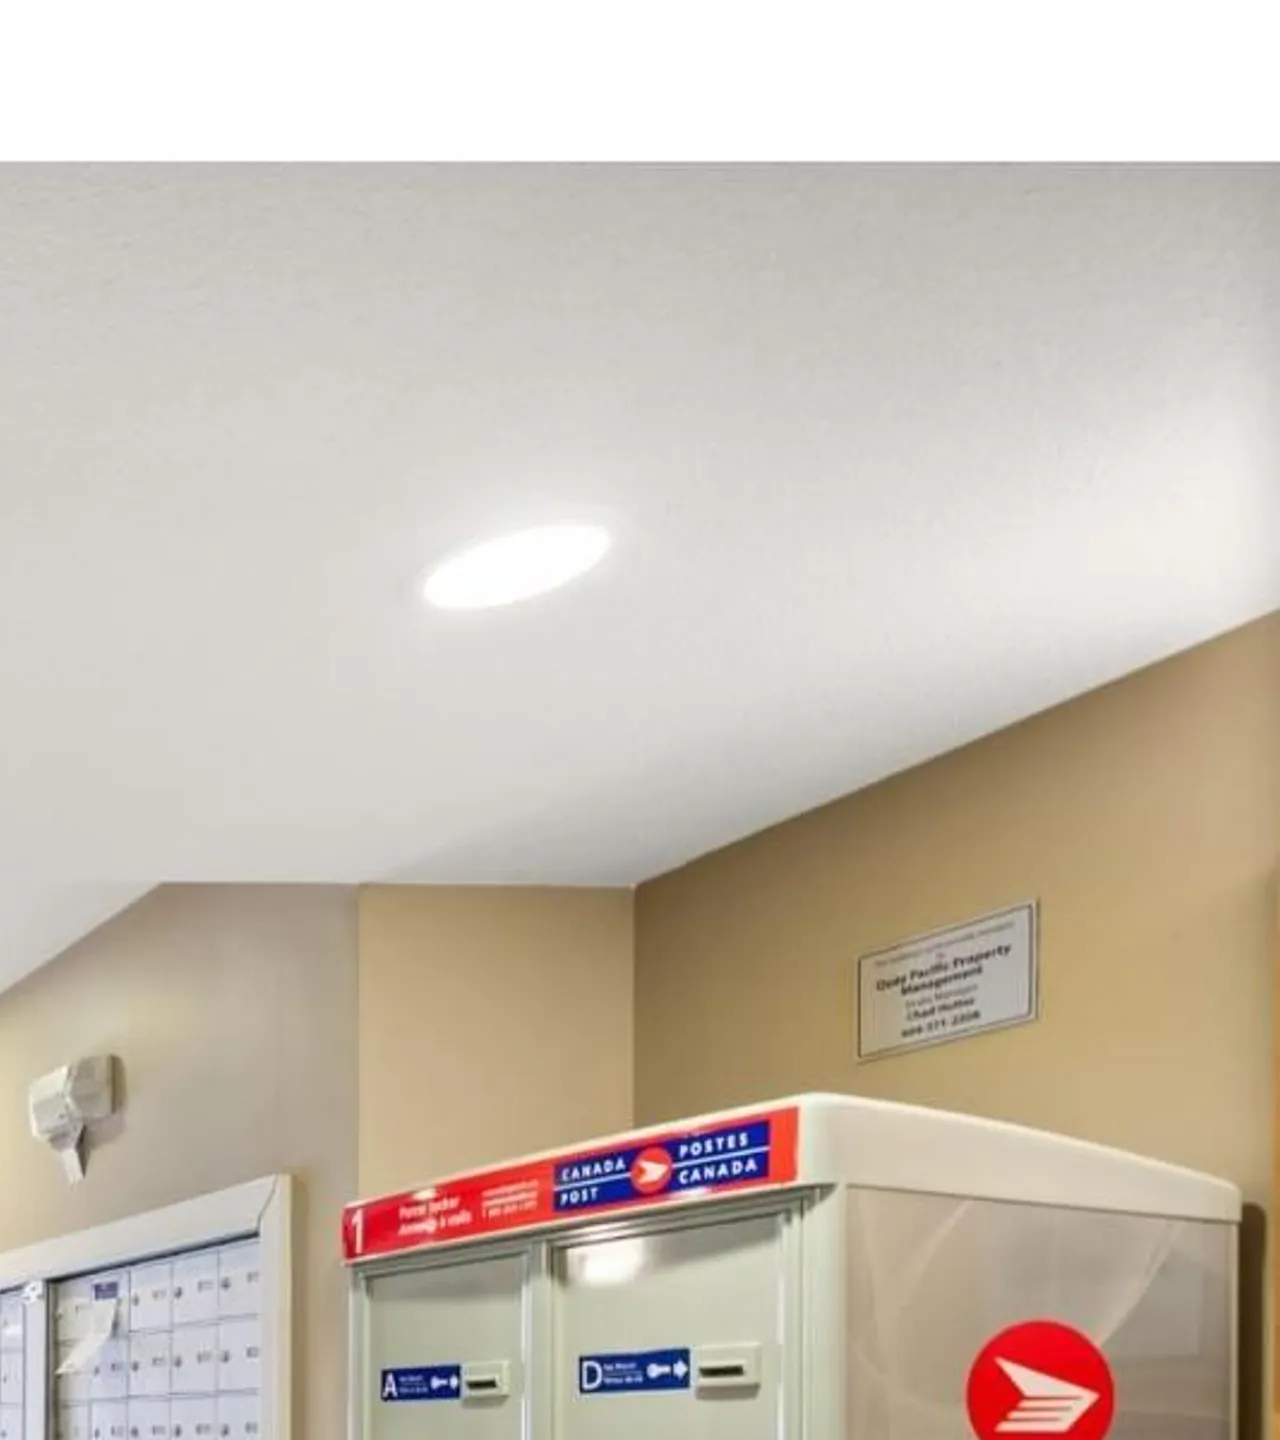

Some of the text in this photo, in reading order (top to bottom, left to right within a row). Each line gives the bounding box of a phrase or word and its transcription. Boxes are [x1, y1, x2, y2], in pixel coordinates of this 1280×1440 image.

[953, 944, 1011, 968] Property
[901, 965, 983, 996] Management
[679, 1132, 749, 1158] POSTES
[561, 1157, 626, 1182] CANADA
[678, 1158, 758, 1184] CANADA
[560, 1187, 599, 1206] POST
[382, 1372, 398, 1399] A
[581, 1360, 602, 1391] D
